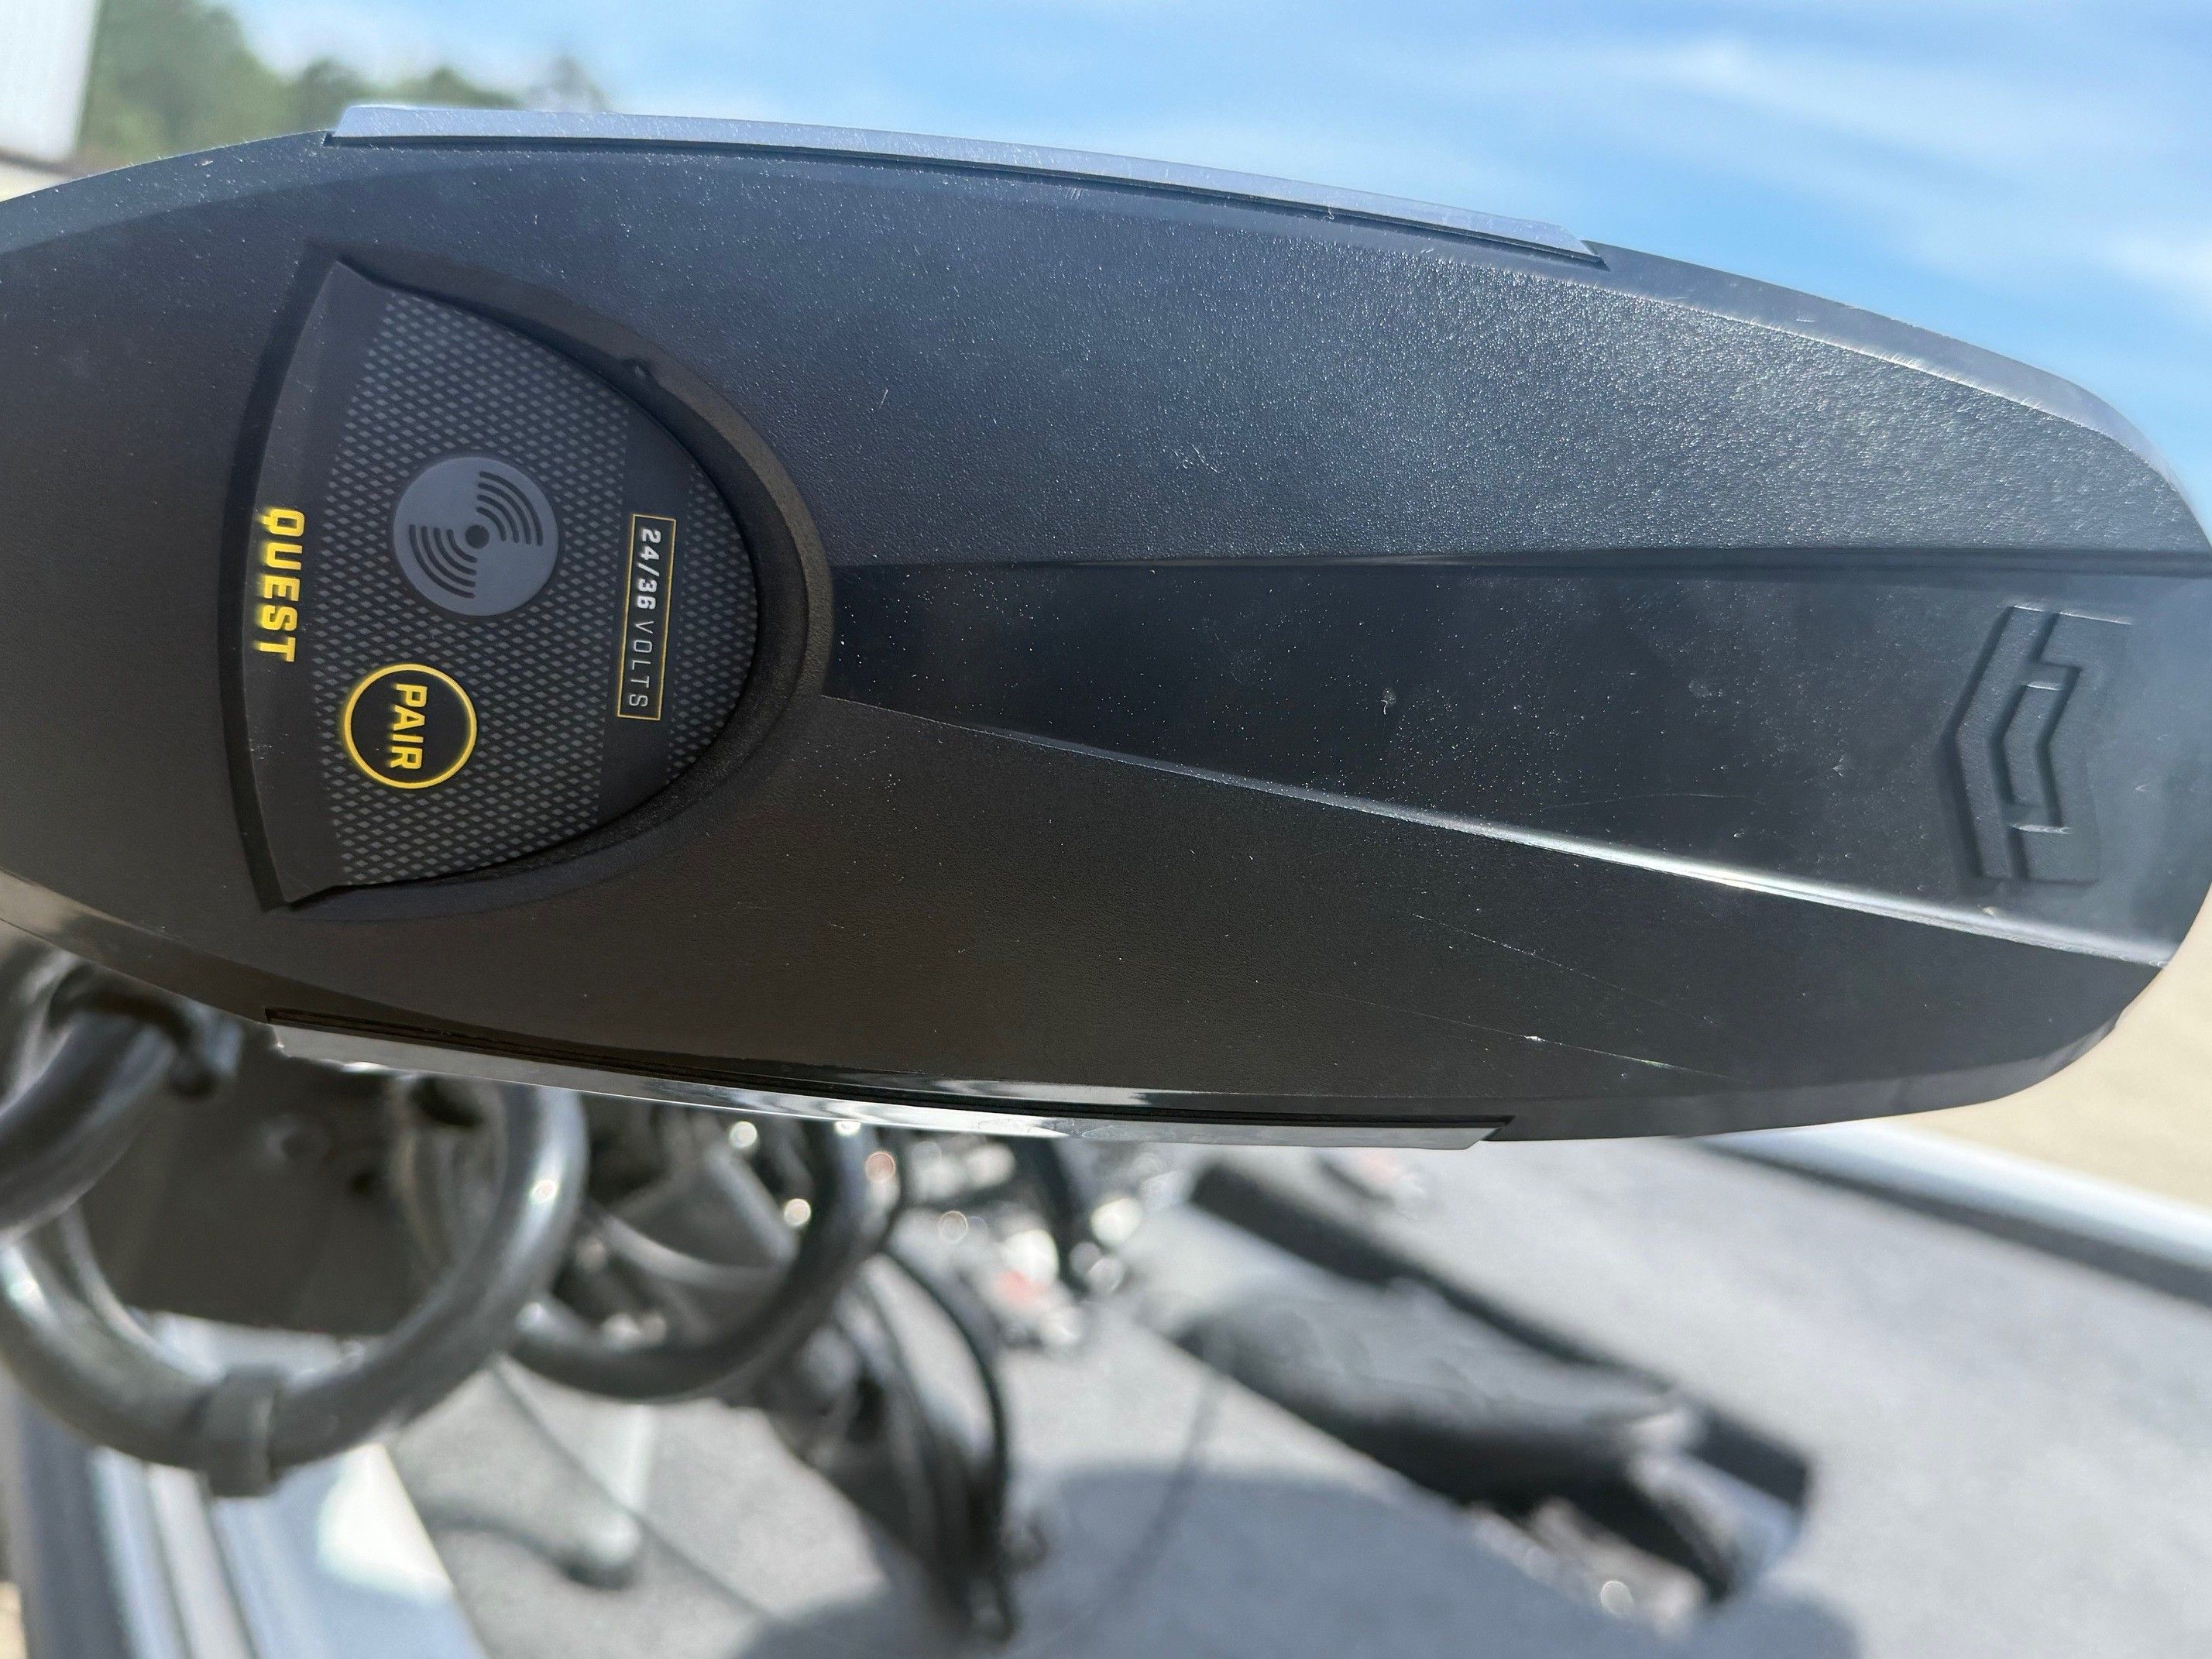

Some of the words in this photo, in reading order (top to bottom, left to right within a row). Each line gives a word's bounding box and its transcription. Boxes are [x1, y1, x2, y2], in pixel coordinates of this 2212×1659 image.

[258, 508, 305, 662] QUEST
[636, 528, 661, 610] 24/36
[628, 620, 654, 707] VOLTS
[390, 683, 428, 770] PAIR
